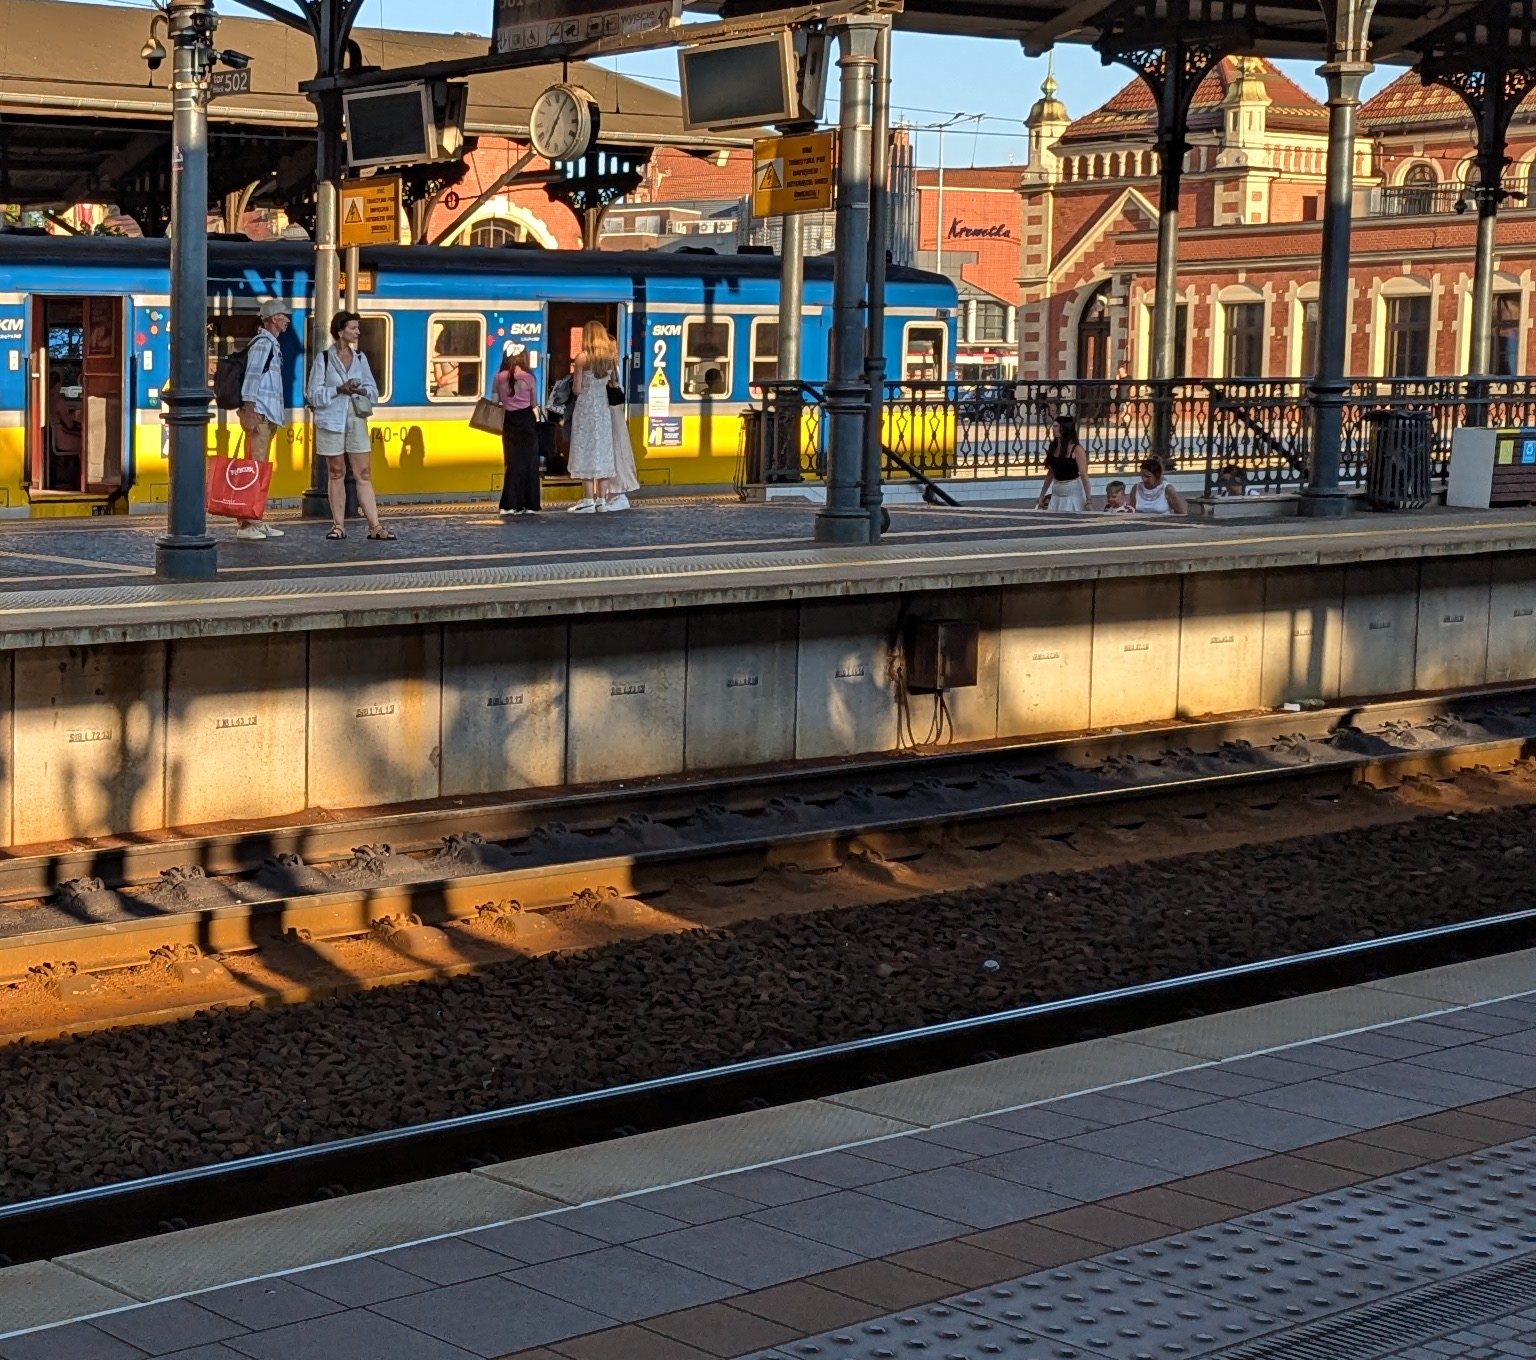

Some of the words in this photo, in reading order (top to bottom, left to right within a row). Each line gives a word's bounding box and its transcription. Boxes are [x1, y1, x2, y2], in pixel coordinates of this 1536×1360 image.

[213, 74, 224, 84] tor
[224, 72, 248, 92] 502
[510, 323, 542, 335] SKM
[652, 324, 682, 336] SKM
[653, 339, 667, 368] 2
[286, 427, 304, 444] 94
